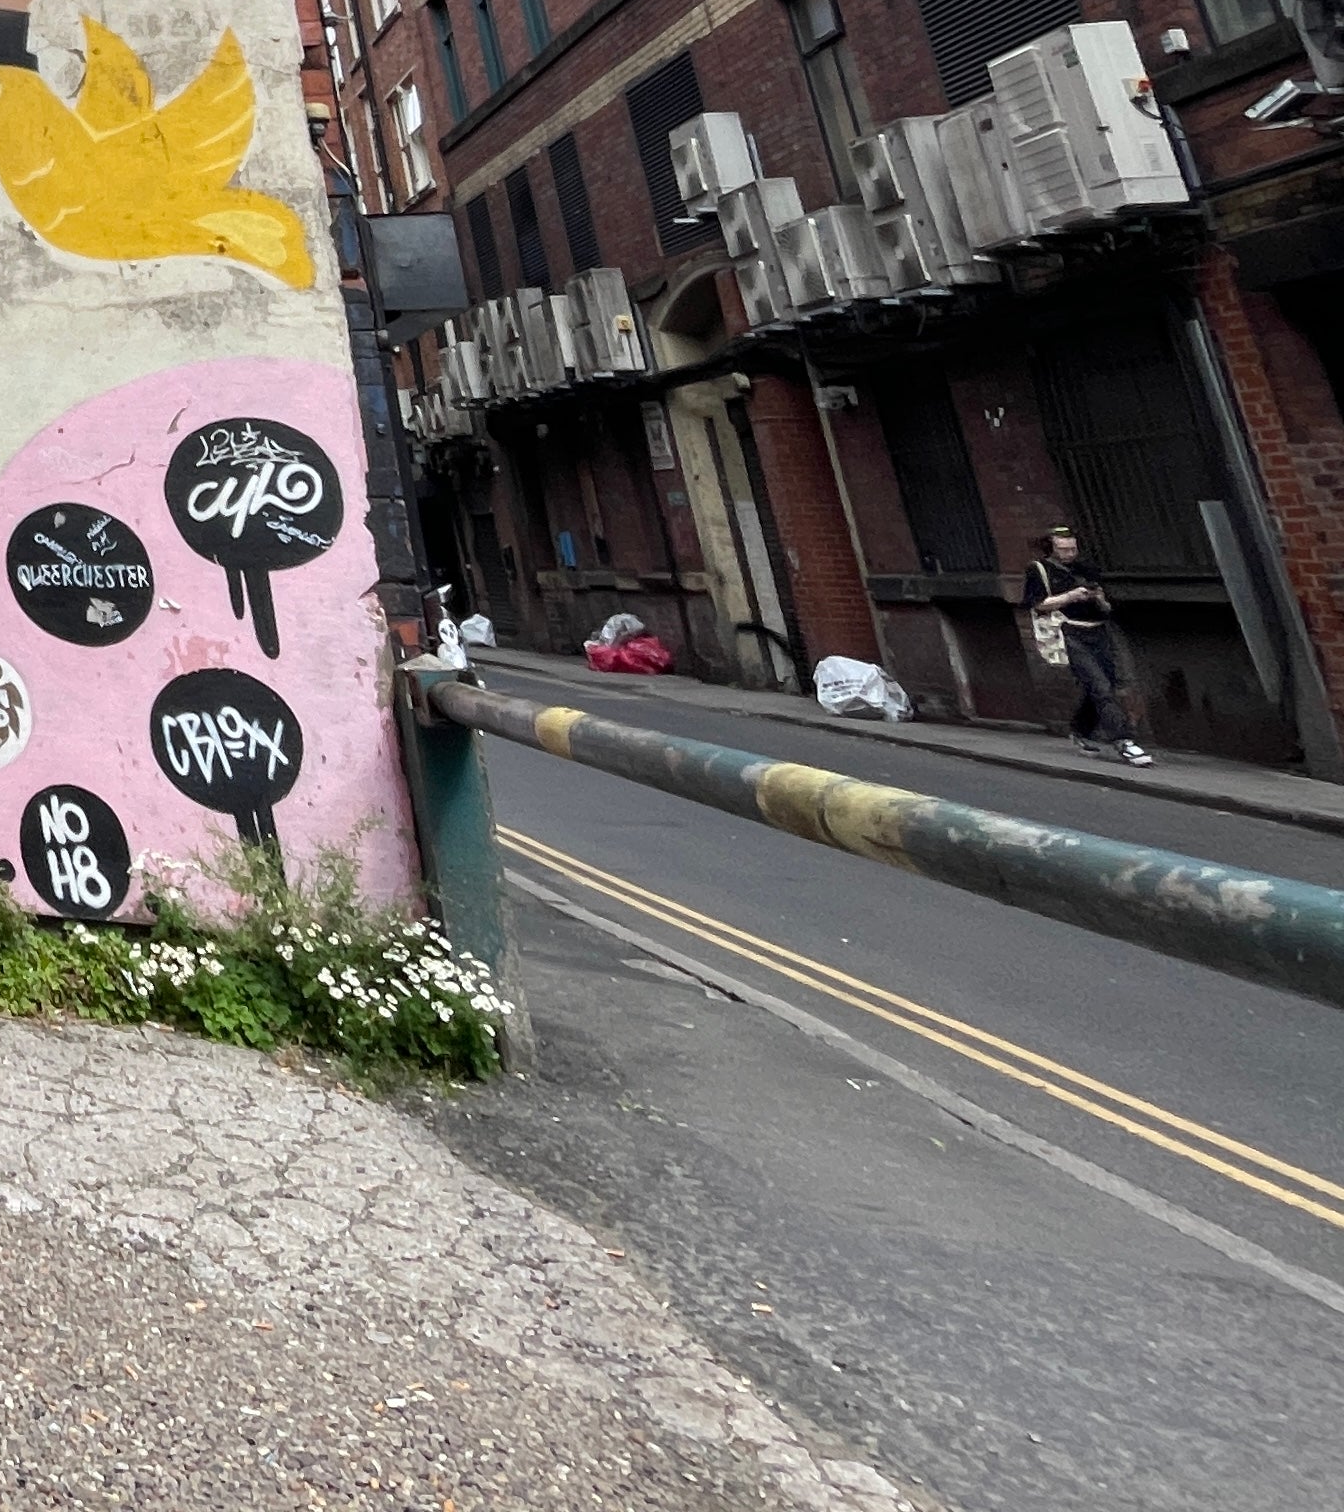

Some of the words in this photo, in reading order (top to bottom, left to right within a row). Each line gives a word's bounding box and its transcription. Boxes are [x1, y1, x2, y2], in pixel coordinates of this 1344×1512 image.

[16, 562, 150, 591] QUEERCHESTER
[39, 794, 89, 844] NO
[46, 844, 111, 909] H8
